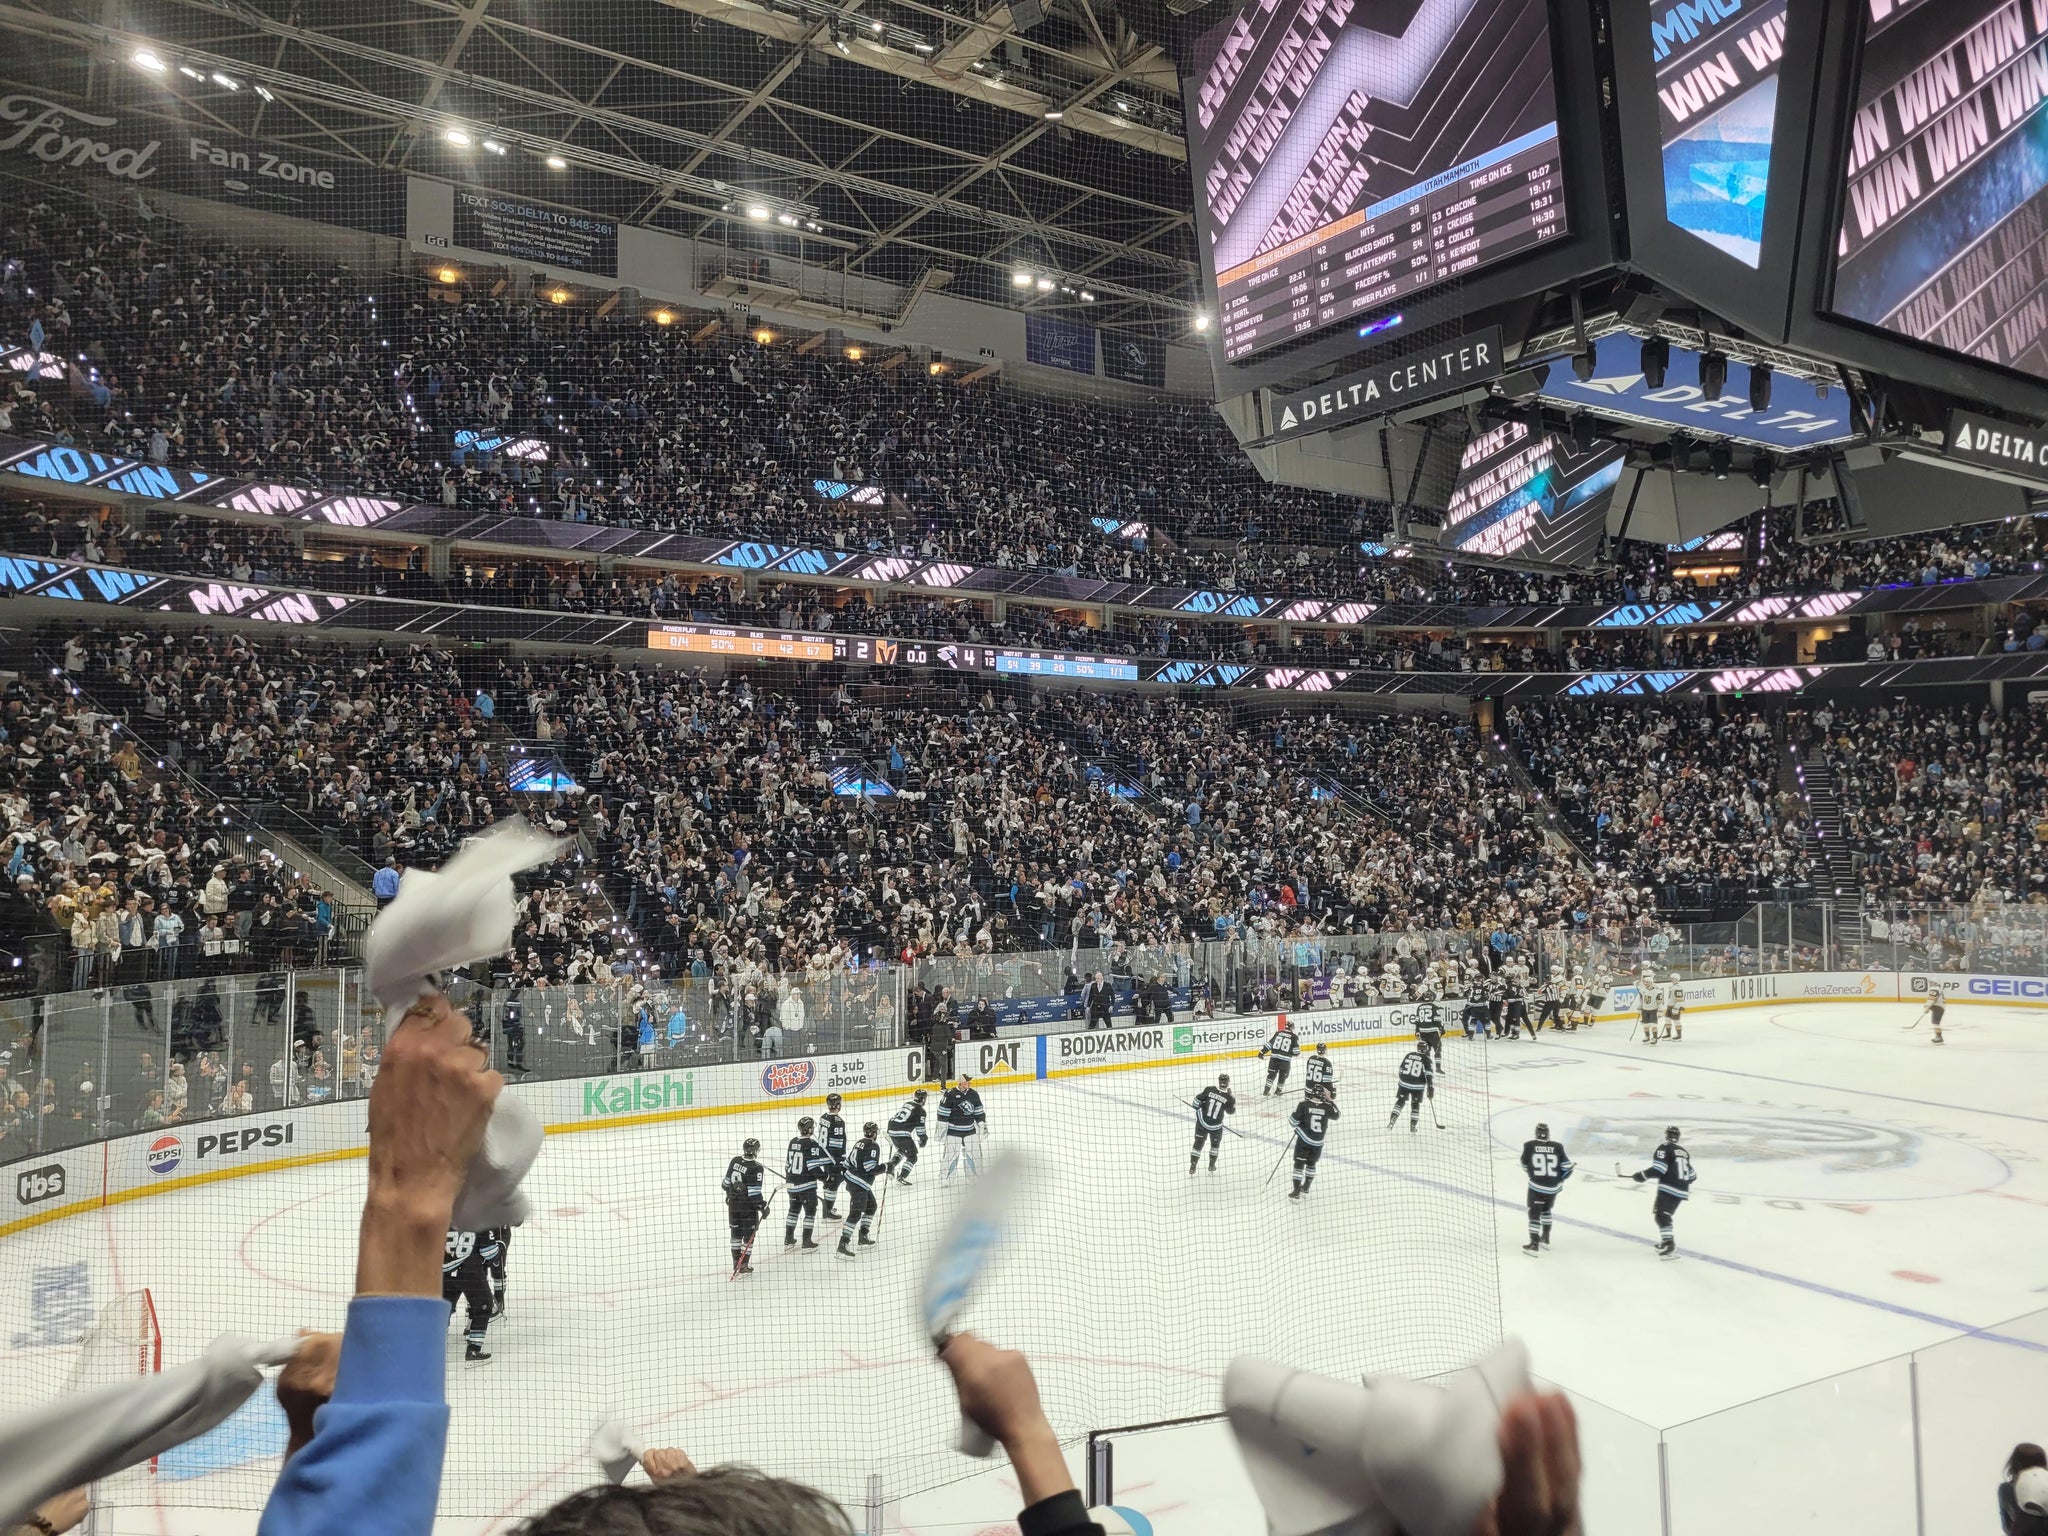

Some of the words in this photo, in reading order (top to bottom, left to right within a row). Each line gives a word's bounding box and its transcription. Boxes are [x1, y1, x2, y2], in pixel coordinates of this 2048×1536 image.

[1261, 26, 1304, 96] WIN
[1284, 26, 1332, 99] WIN
[1894, 47, 1960, 135] WIN
[1964, 1, 2026, 83] WIN
[1658, 51, 1740, 123] WIN
[0, 95, 161, 179] Ford
[1224, 95, 1264, 161] WIN
[1248, 96, 1291, 165] WIN
[1314, 116, 1350, 170] WIN
[1851, 143, 1920, 239] WIN
[1923, 91, 1989, 183] WIN
[1991, 42, 2048, 131] WIN
[190, 138, 250, 171] Fan
[258, 153, 335, 189] Zone
[1314, 149, 1351, 202] WIN
[1424, 179, 1442, 191] UTAH
[1443, 160, 1480, 183] MAMMOTH
[1332, 161, 1370, 215] WIN
[1470, 176, 1488, 190] TIME
[1489, 171, 1499, 182] ON
[1500, 164, 1512, 177] ICE
[1212, 160, 1253, 226] WIN
[1284, 168, 1318, 217] WIN
[1446, 196, 1477, 216] CARCONE
[1527, 164, 1550, 181] 10:07
[460, 193, 489, 208] TEXT
[491, 201, 514, 214] SOS
[517, 206, 550, 222] DELTA
[552, 213, 567, 225] TO
[569, 219, 612, 235] 848-261
[1433, 226, 1442, 236] 67
[1529, 179, 1551, 196] 19:17
[1318, 245, 1327, 256] 42
[1360, 224, 1375, 238] HITS
[1409, 204, 1420, 216] 39
[1434, 239, 1444, 250] 92
[1530, 194, 1553, 211] 19:31
[1537, 224, 1556, 239] 7:41
[1320, 262, 1329, 272] 12
[1345, 244, 1372, 262] BLOCKED
[1373, 233, 1395, 250] SHOTS
[1411, 221, 1421, 233] 20
[1437, 252, 1445, 263] 15
[1532, 209, 1554, 226] 14:30
[492, 241, 509, 250] TEXT
[546, 252, 556, 260] TO
[1950, 238, 1996, 301] WIN
[2000, 198, 2042, 260] WIN
[1321, 277, 1330, 288] 67
[1346, 264, 1362, 278] SHOT
[1363, 249, 1397, 270] ATTEMPTS
[1412, 239, 1423, 250] 54
[1248, 276, 1261, 287] TIME
[1261, 273, 1269, 282] ON
[1270, 267, 1279, 279] ICE
[1289, 270, 1306, 283] 22:21
[1291, 282, 1308, 295] 19:06
[1320, 292, 1335, 304] 50%
[1355, 272, 1382, 290] FACEOFF
[1382, 270, 1390, 279] %
[1411, 255, 1428, 268] 50%
[1990, 251, 2034, 316] WIN
[1292, 295, 1309, 308] 17:57
[1322, 309, 1334, 319] 0/4
[1352, 291, 1375, 308] POWER
[1375, 284, 1397, 300] PLAYS
[1415, 272, 1427, 283] 1/1
[1292, 308, 1310, 320] 21:37
[1294, 320, 1311, 332] 13:56
[2003, 292, 2048, 359] WIN
[1303, 379, 1381, 422] DELTA
[1390, 343, 1490, 393] CENTER
[1976, 428, 2034, 463] DELTA
[1468, 472, 1495, 497] WIN
[1498, 453, 1524, 478] WIN
[1450, 499, 1477, 526] WIN
[1480, 481, 1506, 508] WIN
[1509, 463, 1534, 490] WIN
[669, 637, 689, 648] 0/4
[711, 639, 735, 650] 50%
[751, 642, 764, 652] 12
[779, 644, 793, 655] 42
[807, 645, 820, 656] 67
[834, 646, 846, 657] 31
[857, 642, 868, 658] 2
[907, 650, 927, 664] 0.0
[964, 649, 975, 666] 4
[984, 657, 995, 666] 12
[1007, 660, 1018, 669] 54
[1030, 661, 1041, 671] 39
[1053, 663, 1065, 672] 20
[1076, 665, 1094, 674] 50%
[1110, 667, 1122, 677] 1/1
[1731, 976, 1778, 1000] NOBULL
[1803, 985, 1863, 996] AstraZeneca
[1968, 978, 2048, 997] GEIC
[1614, 993, 1635, 1008] SAP
[1313, 1015, 1383, 1035] MassMutual
[1060, 1030, 1164, 1057] BODYARMOR
[1272, 1035, 1292, 1053] 88
[768, 1061, 808, 1080] Jersey
[830, 1063, 838, 1073] a
[842, 1058, 865, 1072] sub
[979, 1042, 1021, 1075] CAT
[1061, 1058, 1086, 1066] SPORTS
[1087, 1056, 1107, 1064] DRINK
[1402, 1058, 1424, 1078] 38
[828, 1073, 867, 1088] above
[583, 1072, 694, 1116] Kalshi
[1206, 1098, 1223, 1120] 11
[1310, 1115, 1322, 1133] 6
[196, 1122, 294, 1160] PEPSI
[148, 1148, 182, 1162] PEPSI
[1531, 1153, 1558, 1177] 92
[1656, 1150, 1665, 1159] 15
[756, 1172, 763, 1181] 9
[1675, 1156, 1690, 1181] 15
[20, 1169, 62, 1200] tbs
